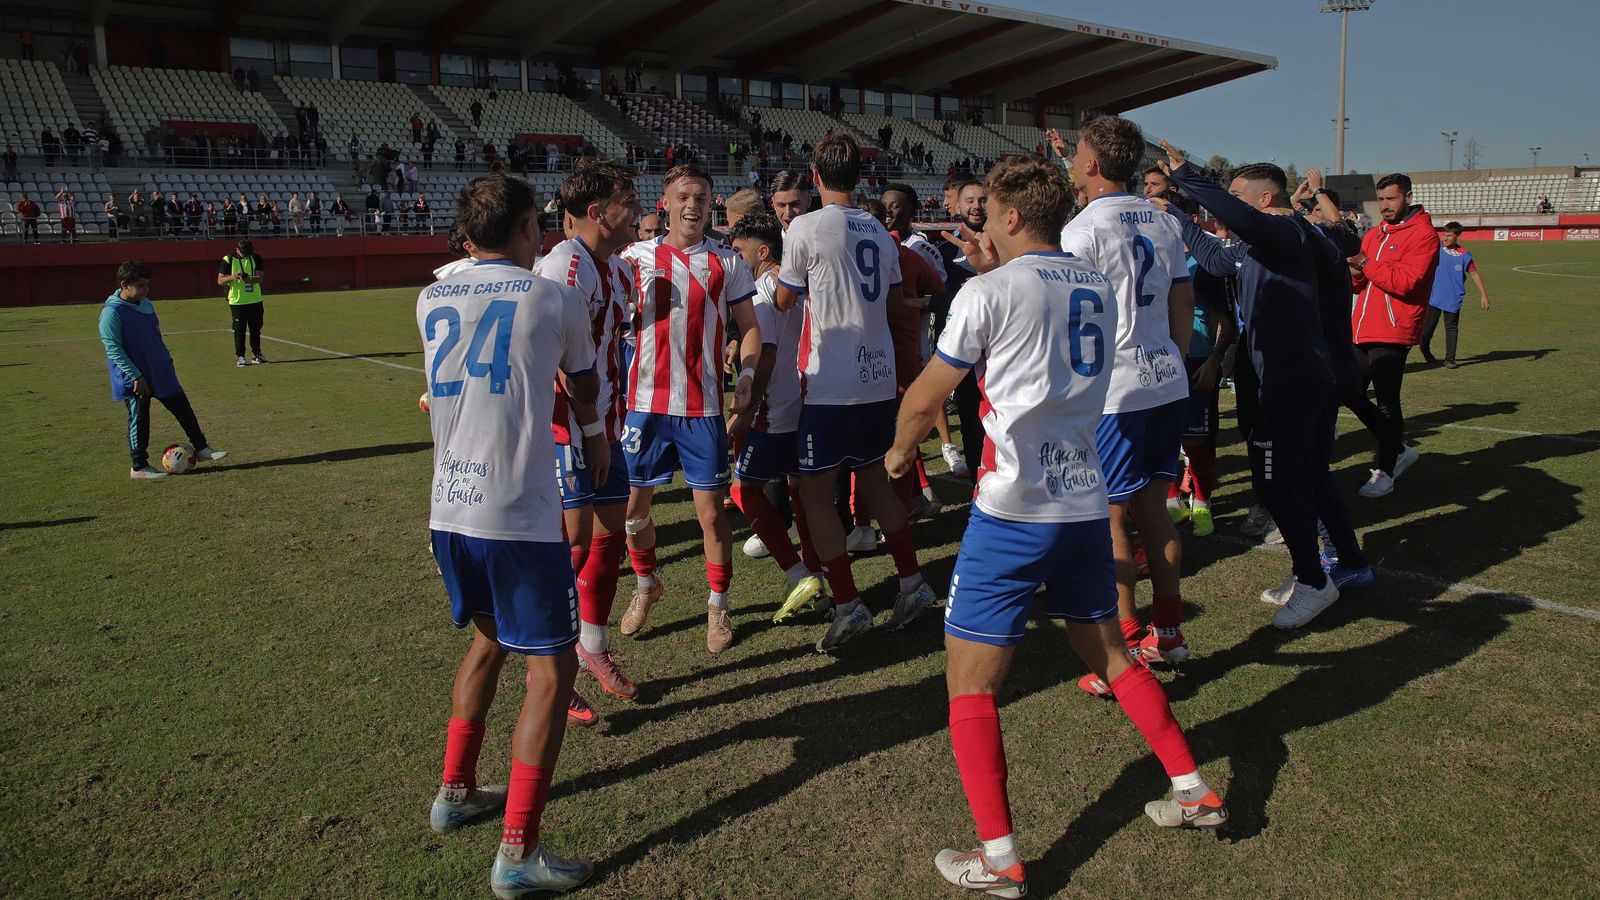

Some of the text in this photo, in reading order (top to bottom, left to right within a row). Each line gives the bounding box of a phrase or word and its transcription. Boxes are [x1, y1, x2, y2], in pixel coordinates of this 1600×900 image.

[1077, 24, 1169, 47] MIRADOR
[1119, 211, 1154, 225] ARAUZ
[855, 239, 881, 303] 9
[1132, 234, 1155, 307] 2
[426, 279, 533, 300] OSCAR CASTRO
[1068, 287, 1105, 378] 6
[425, 299, 518, 398] 24
[621, 424, 642, 454] 23
[447, 479, 487, 507] Gusta
[1063, 466, 1098, 491] Gusta
